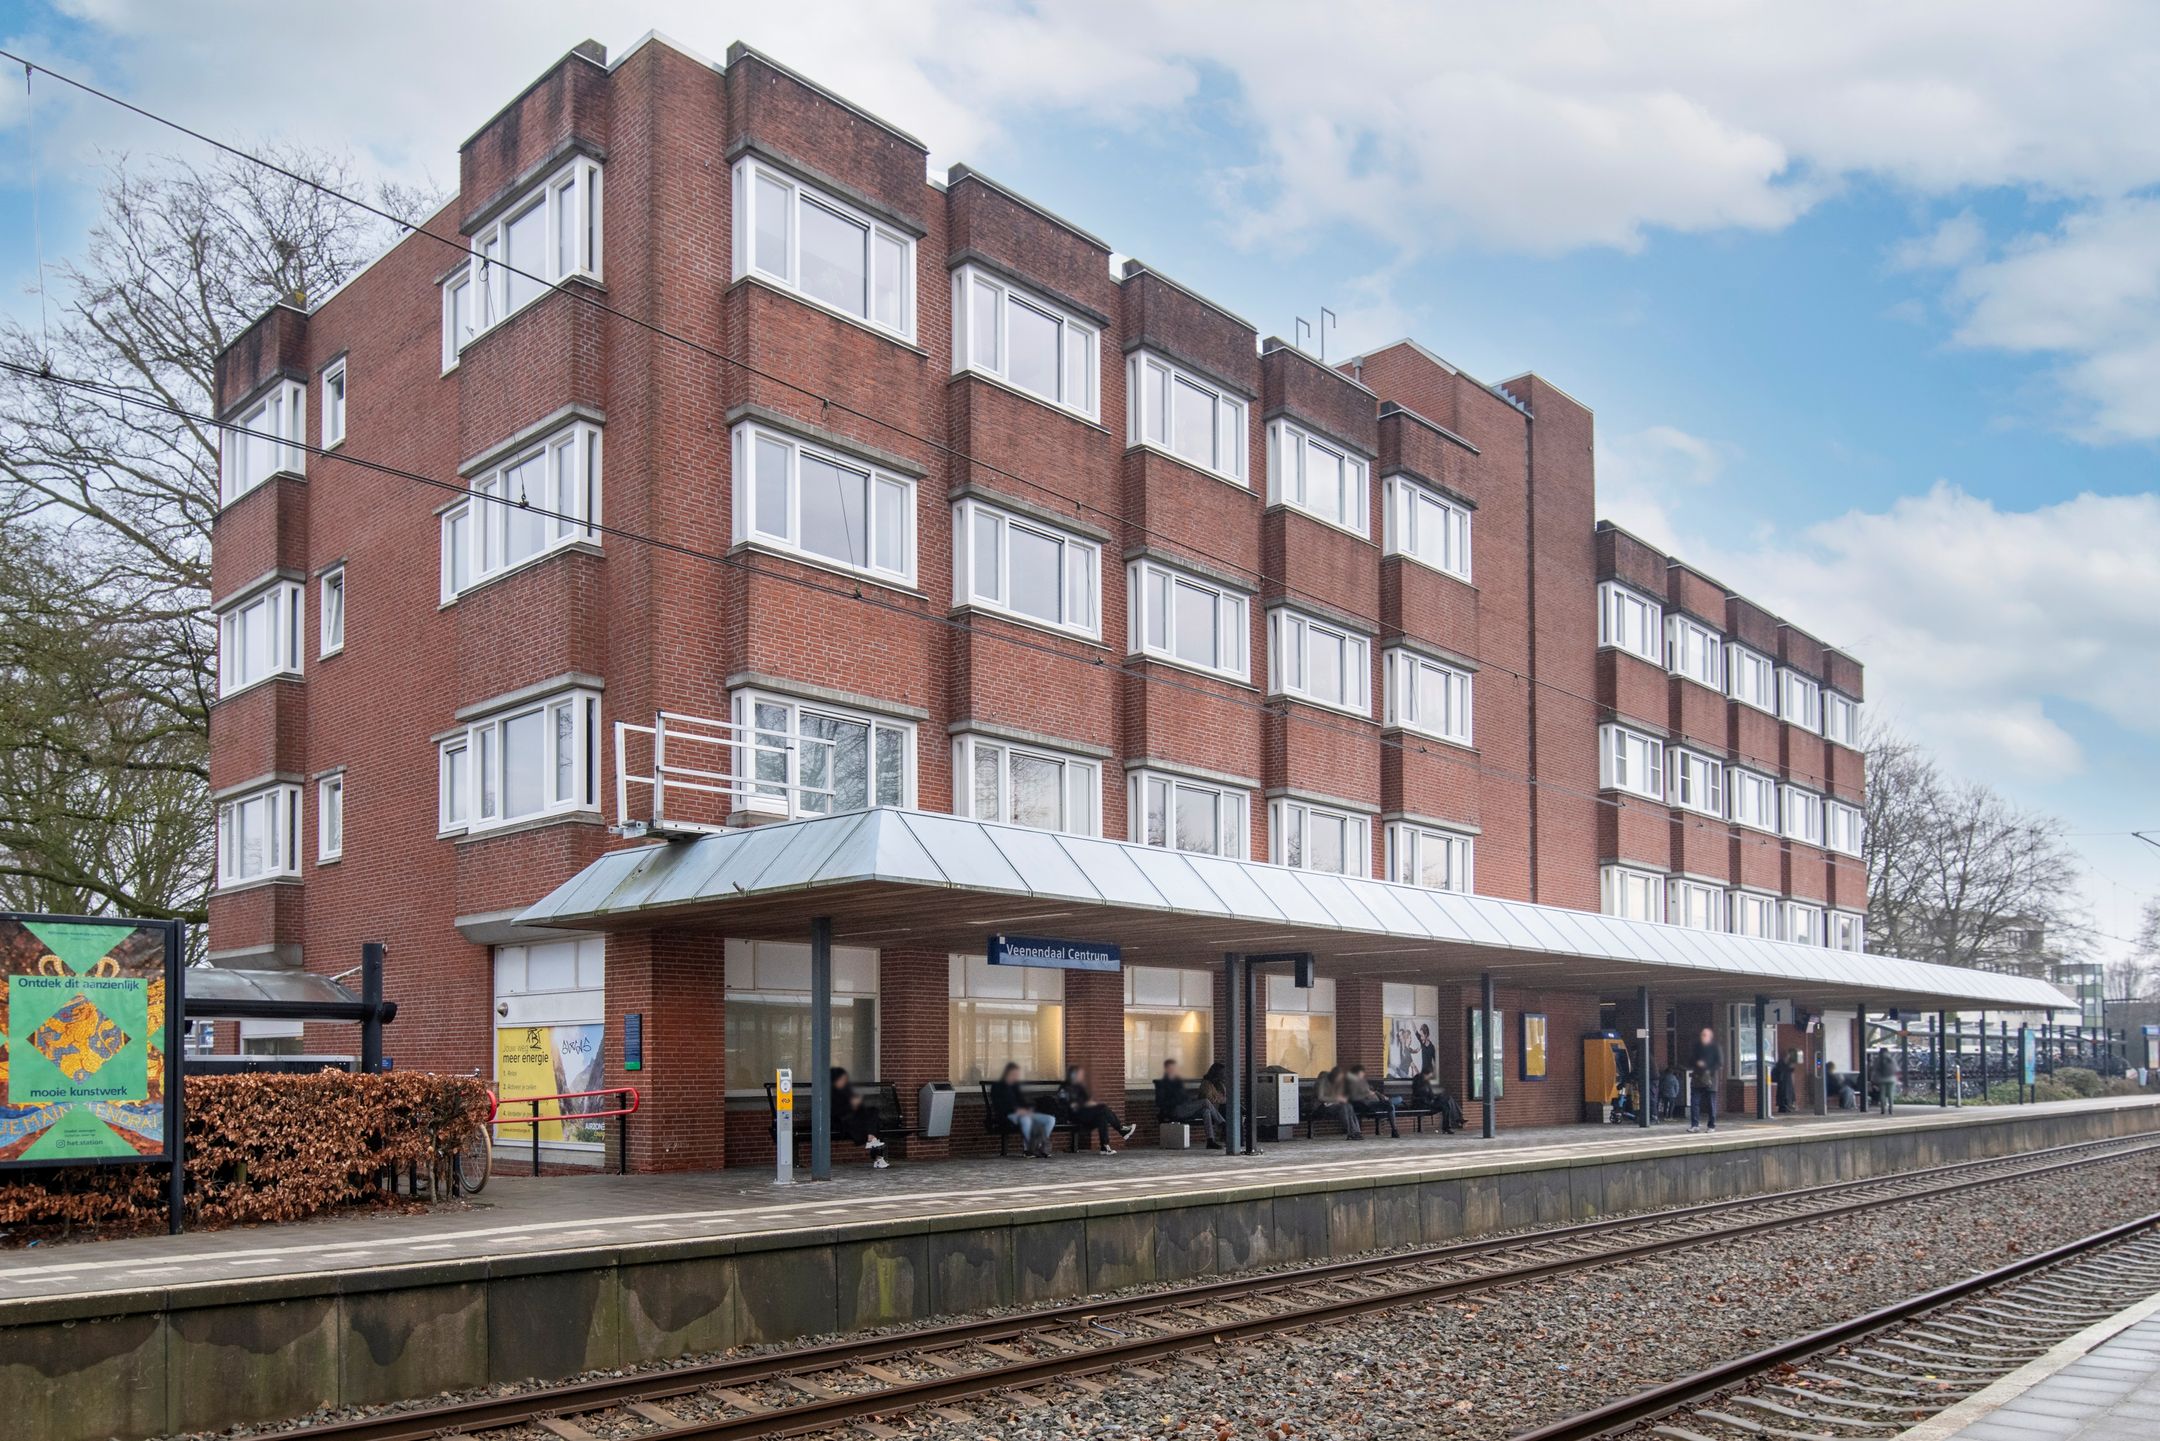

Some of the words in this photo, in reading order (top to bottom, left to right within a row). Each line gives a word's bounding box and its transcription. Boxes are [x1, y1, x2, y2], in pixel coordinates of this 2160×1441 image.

[1006, 944, 1065, 959] Veenendaal
[1068, 948, 1109, 961] Centrum
[18, 977, 61, 988] Ontdek
[65, 977, 79, 989] dit
[82, 979, 139, 991] aanzienlijk
[1773, 1008, 1780, 1022] 1
[503, 1054, 520, 1063] meer
[522, 1051, 549, 1065] energie
[30, 1087, 66, 1097] mooie
[70, 1086, 128, 1097] kunstwerk
